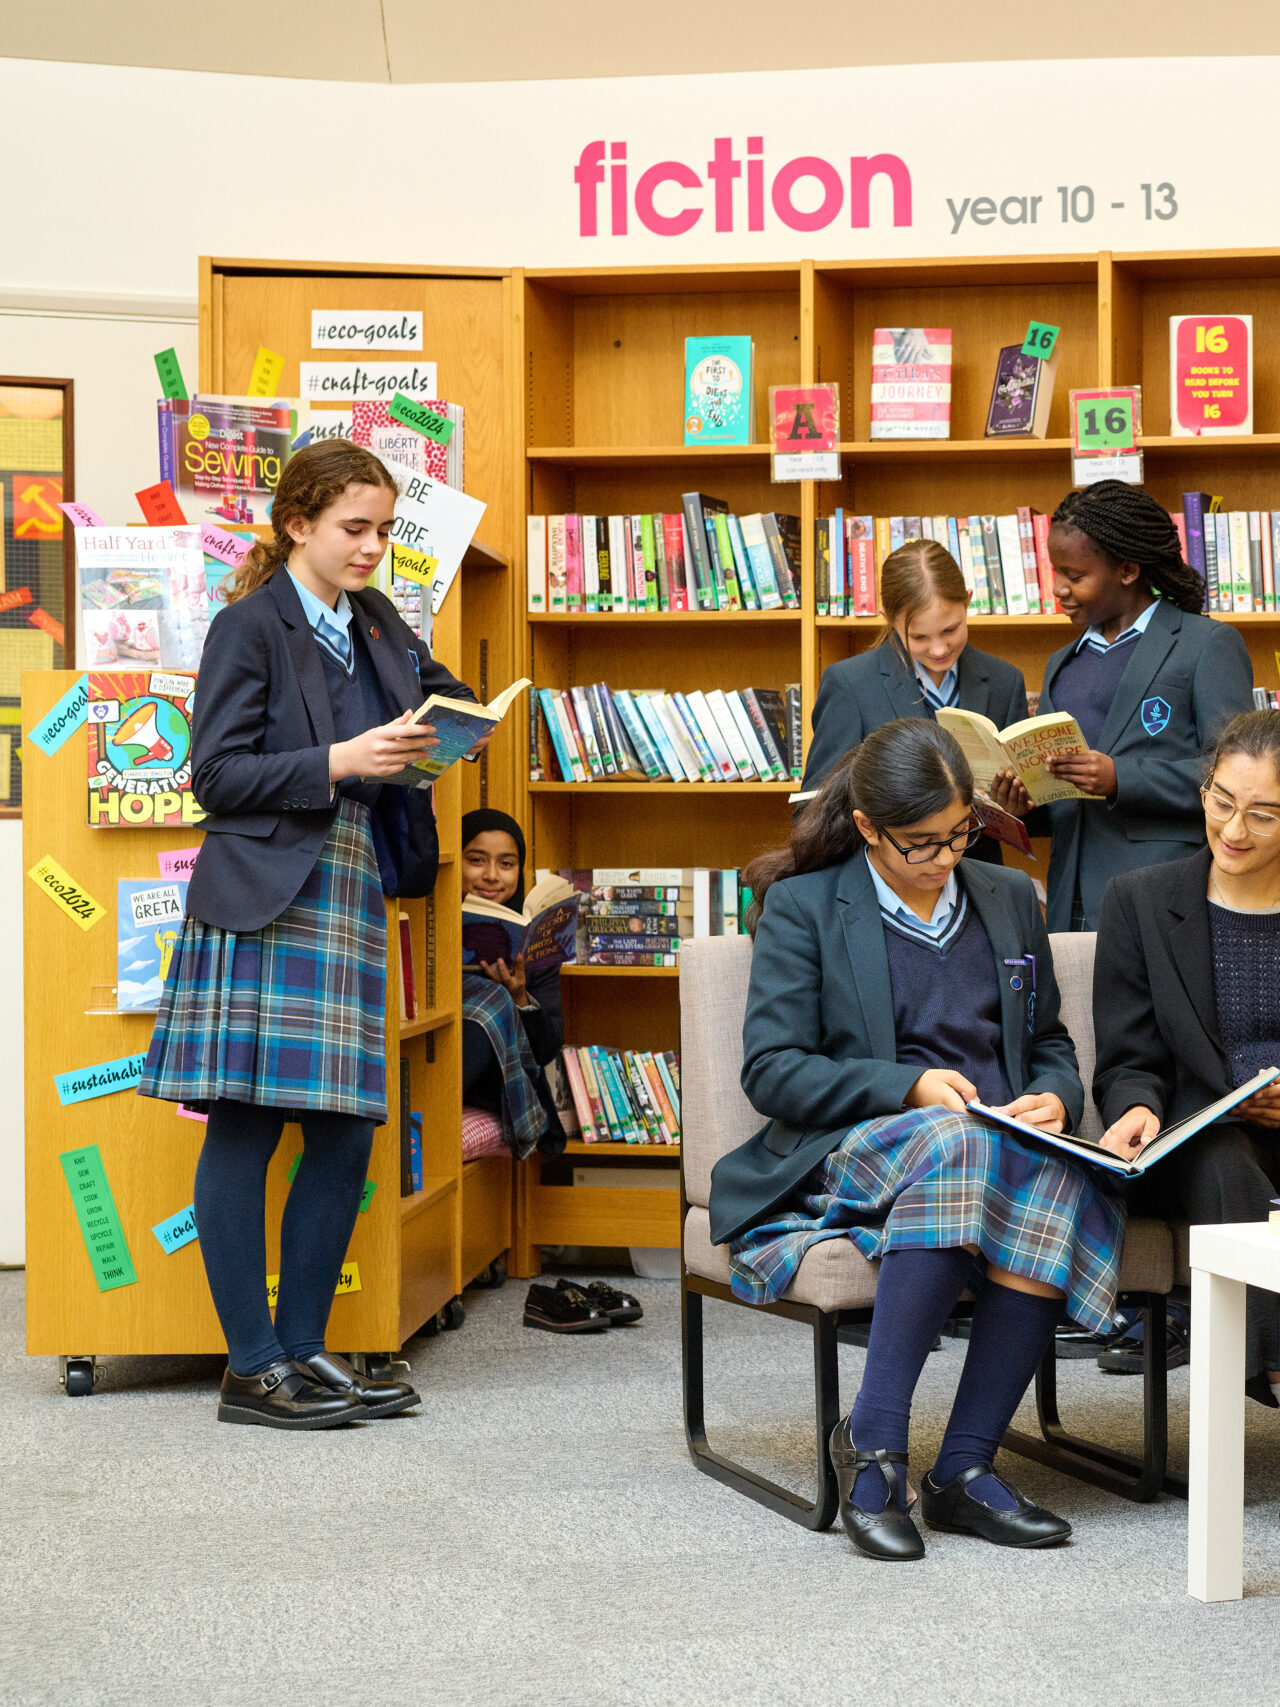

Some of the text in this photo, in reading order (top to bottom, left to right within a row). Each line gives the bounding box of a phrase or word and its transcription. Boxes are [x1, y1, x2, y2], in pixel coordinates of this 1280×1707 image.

[574, 136, 913, 237] fiction
[945, 195, 1043, 234] year
[1057, 185, 1095, 223] 10
[1140, 182, 1179, 220] 13
[317, 316, 417, 344] #eco-goals
[1028, 328, 1054, 348] 16
[1195, 326, 1228, 354] 16
[706, 367, 726, 375] FIRST
[1191, 366, 1233, 375] BOOKS TO
[307, 368, 428, 395] #craft-goals
[1185, 378, 1239, 387] READ BEFORE
[706, 386, 719, 396] DIE
[880, 385, 943, 399] JOURNEY
[1191, 389, 1233, 399] YOU TURN
[708, 410, 723, 428] END
[1204, 404, 1221, 419] 16
[394, 403, 445, 436] #eco2024
[787, 403, 823, 440] A
[1084, 407, 1126, 435] 16
[205, 441, 219, 450] New
[220, 442, 248, 453] Complete
[249, 445, 266, 454] Guide
[379, 437, 419, 450] LIBERTY
[185, 441, 280, 487] Sewing
[406, 477, 433, 504] BE
[390, 516, 429, 543] ORE
[84, 535, 120, 550] Half
[858, 574, 866, 592] END
[42, 685, 89, 745] #eco-goal
[1009, 724, 1076, 752] WELCOME
[1035, 740, 1053, 751] TO
[90, 791, 207, 823] HOPE
[37, 866, 96, 919] #eco2024
[132, 888, 176, 902] WE ARE ALL
[135, 899, 180, 919] GRETA
[61, 1053, 147, 1095] #sustainabi
[74, 1156, 86, 1165] KNIT
[77, 1169, 90, 1177] SEW
[79, 1180, 96, 1190] CRAFT
[83, 1193, 98, 1202] COOK
[86, 1206, 102, 1215] GROW
[87, 1217, 109, 1228] RECYCLE
[91, 1229, 112, 1240] UPCYCLE
[96, 1242, 115, 1252] REPAIR
[102, 1255, 117, 1264] WALK
[103, 1267, 125, 1280] THINK
